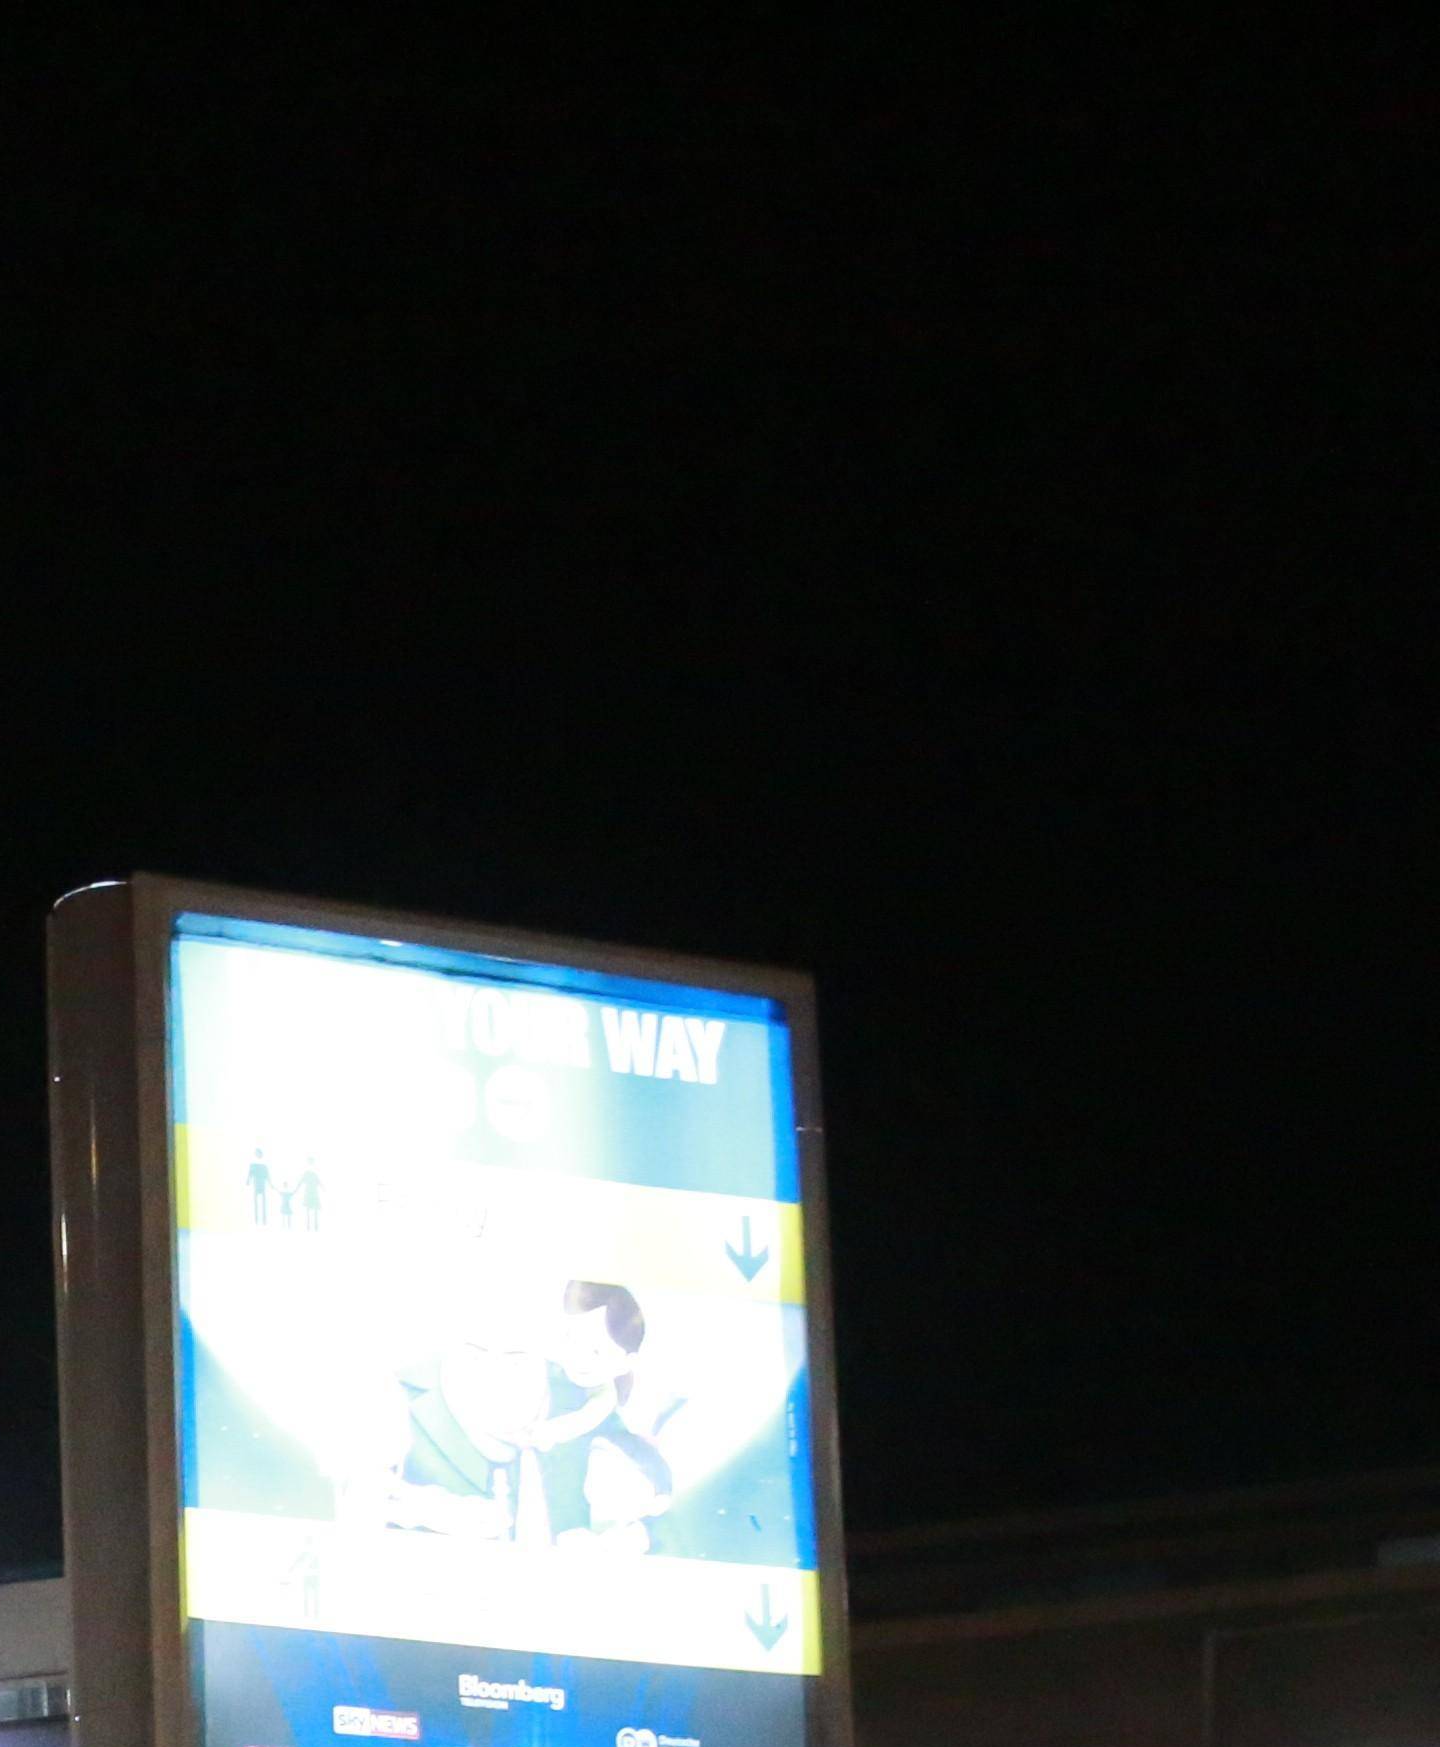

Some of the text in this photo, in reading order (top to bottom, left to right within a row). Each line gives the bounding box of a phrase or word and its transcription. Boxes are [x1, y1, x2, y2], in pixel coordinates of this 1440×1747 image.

[600, 1007, 726, 1085] WAY
[458, 1673, 566, 1710] Bloomberg
[369, 1713, 418, 1736] NEWS
